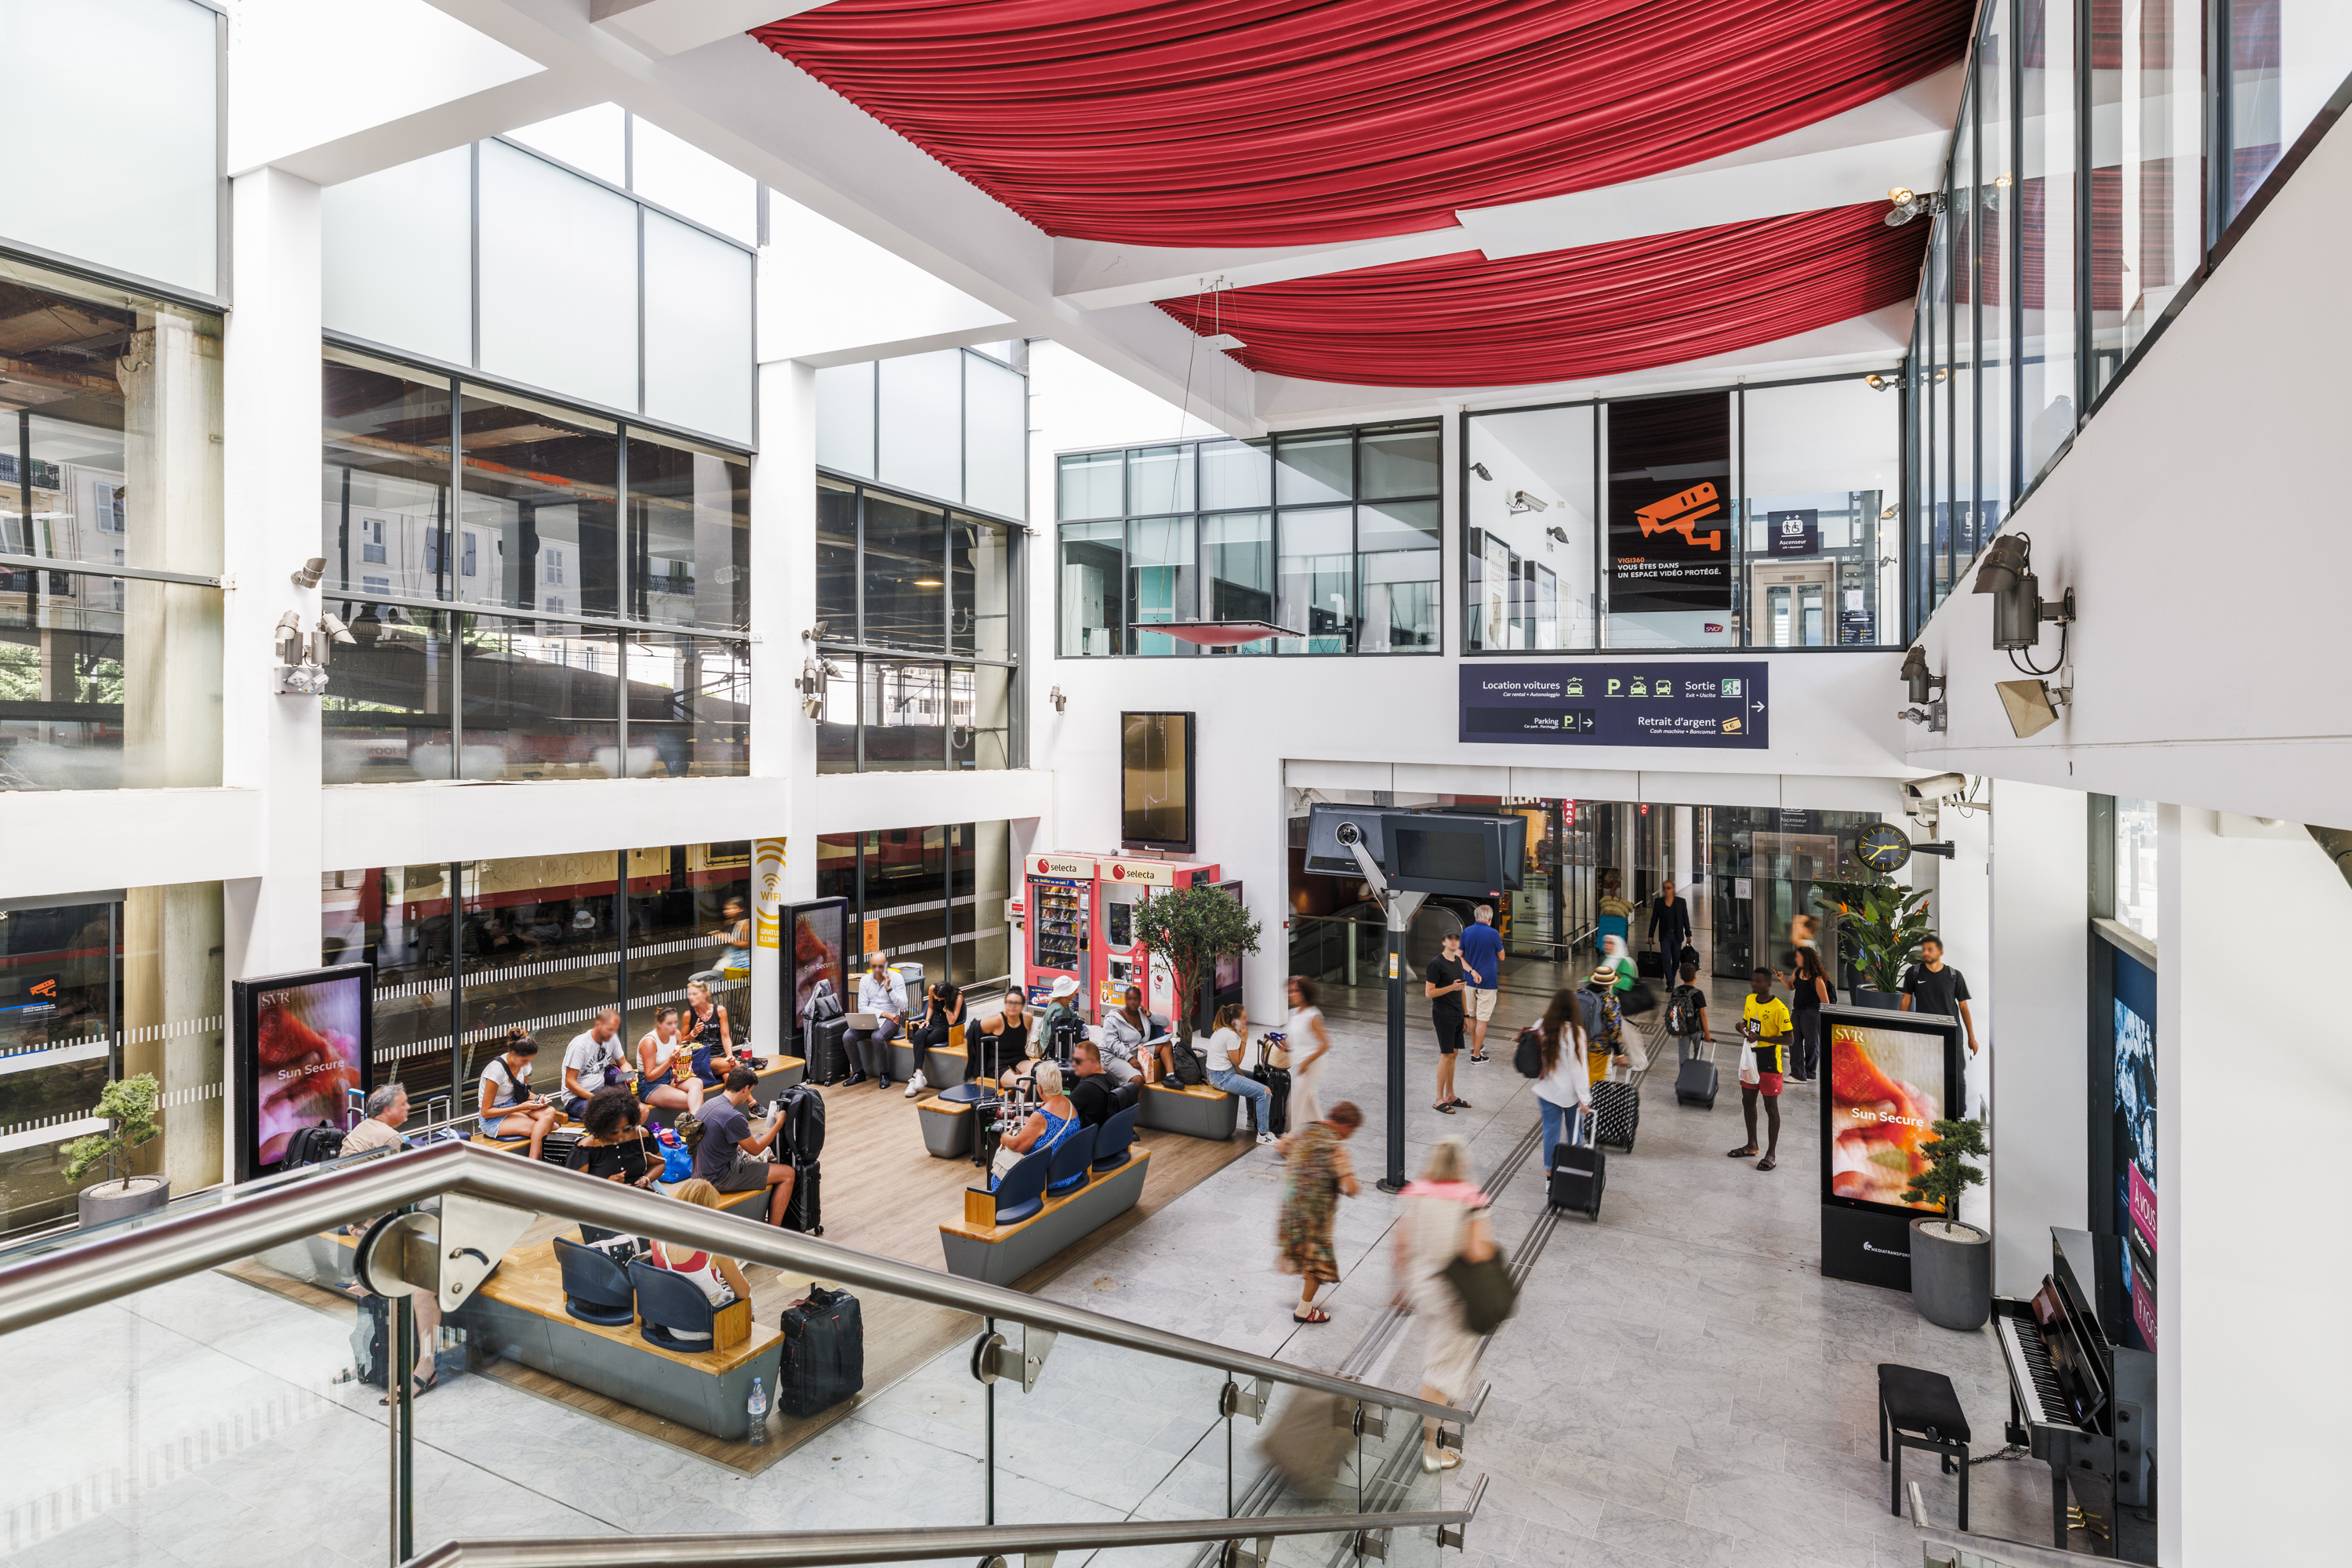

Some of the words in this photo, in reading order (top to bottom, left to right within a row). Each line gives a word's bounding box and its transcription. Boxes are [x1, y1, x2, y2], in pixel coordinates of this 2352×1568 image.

[1685, 568, 1722, 576] PROTÉGÉ.
[1483, 681, 1521, 690] Location
[1523, 681, 1560, 690] voitures
[1686, 681, 1715, 691] Sortie
[1638, 717, 1671, 726] Retrait
[1675, 717, 1715, 728] d'argent
[1051, 863, 1077, 873] selecta
[1127, 869, 1155, 880] selecta
[817, 961, 835, 971] Secure
[1102, 982, 1114, 991] PRIX
[262, 992, 290, 1007] SVR
[1750, 1021, 1761, 1033] 1&1
[1835, 1028, 1865, 1043] SVR
[278, 1068, 301, 1080] Sun
[304, 1060, 345, 1075] Secure
[1852, 1107, 1876, 1121] Sun
[1880, 1112, 1924, 1127] Secure
[2140, 1192, 2156, 1231] VOUS
